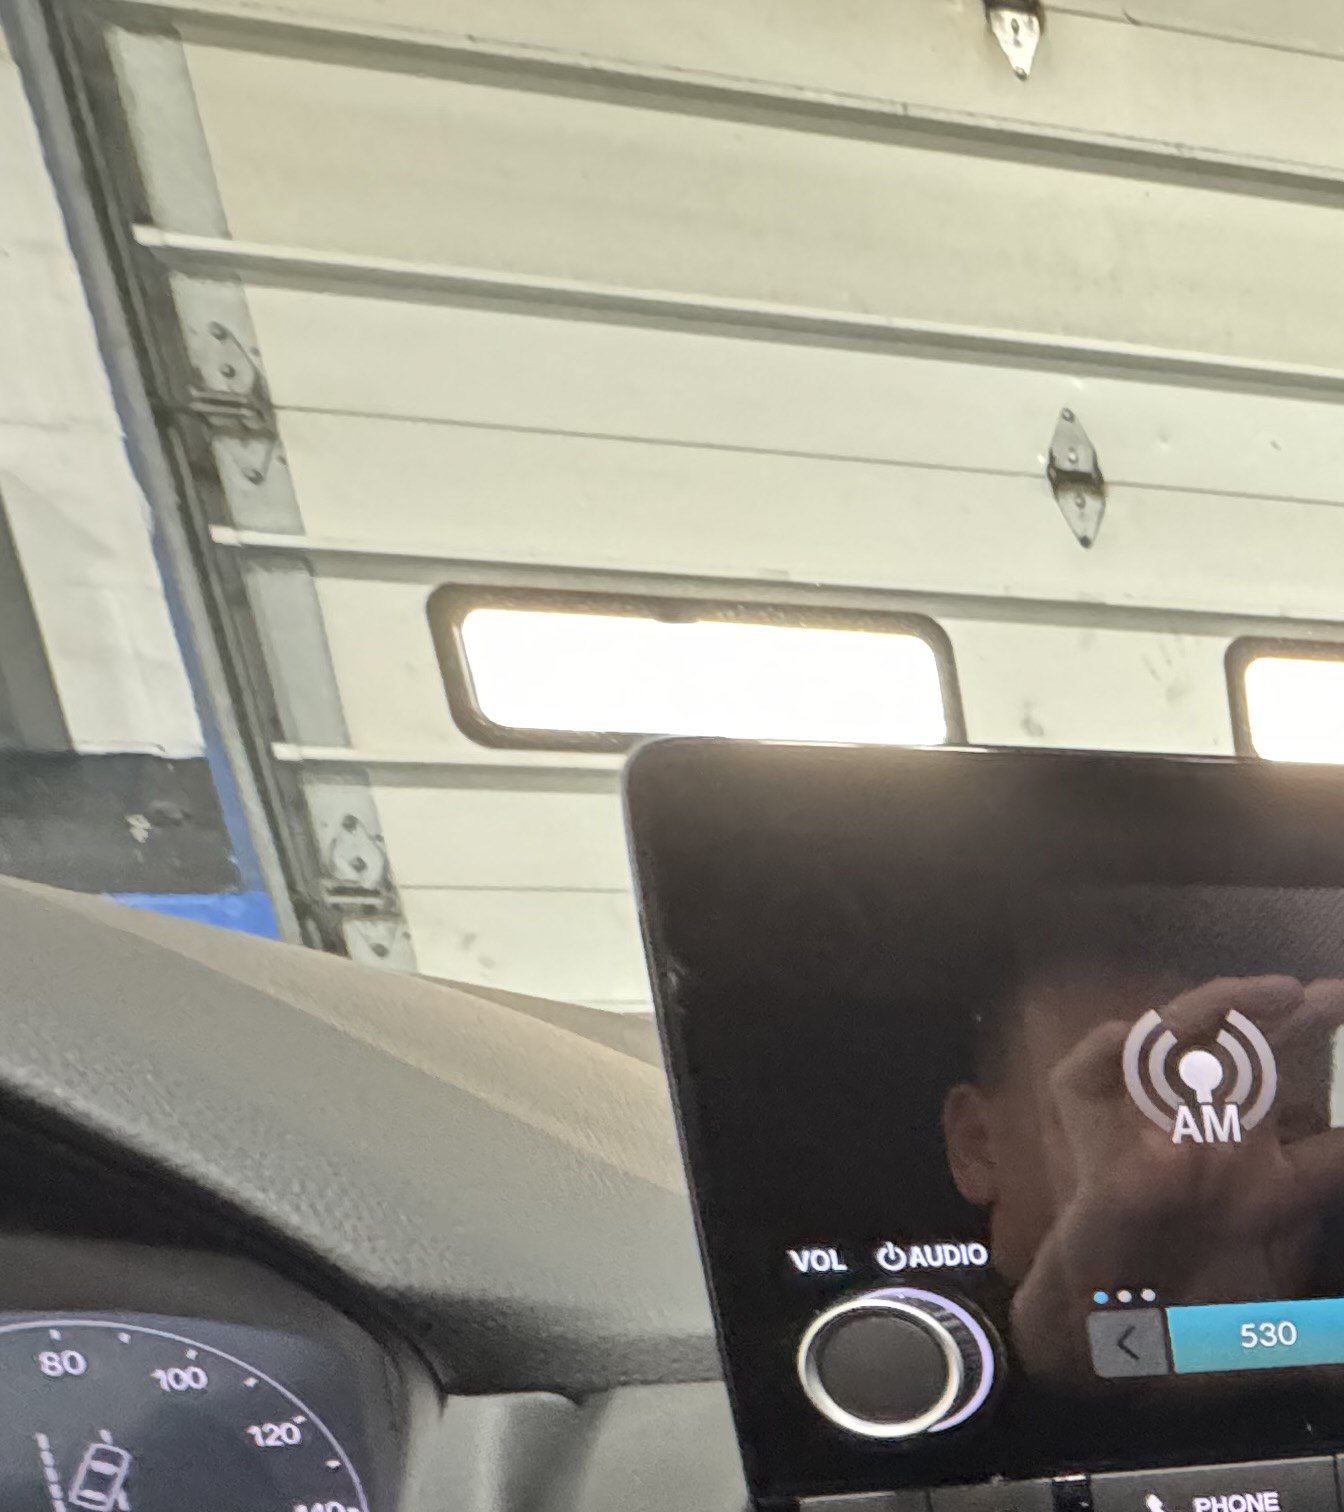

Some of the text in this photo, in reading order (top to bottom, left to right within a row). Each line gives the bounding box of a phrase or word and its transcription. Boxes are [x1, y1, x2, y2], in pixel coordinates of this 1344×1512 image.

[1169, 1101, 1242, 1144] AM
[787, 1242, 989, 1273] VOL AUDIO
[1240, 1321, 1297, 1348] 530
[38, 1349, 86, 1377] 80
[150, 1366, 208, 1391] 100
[247, 1422, 301, 1447] 120
